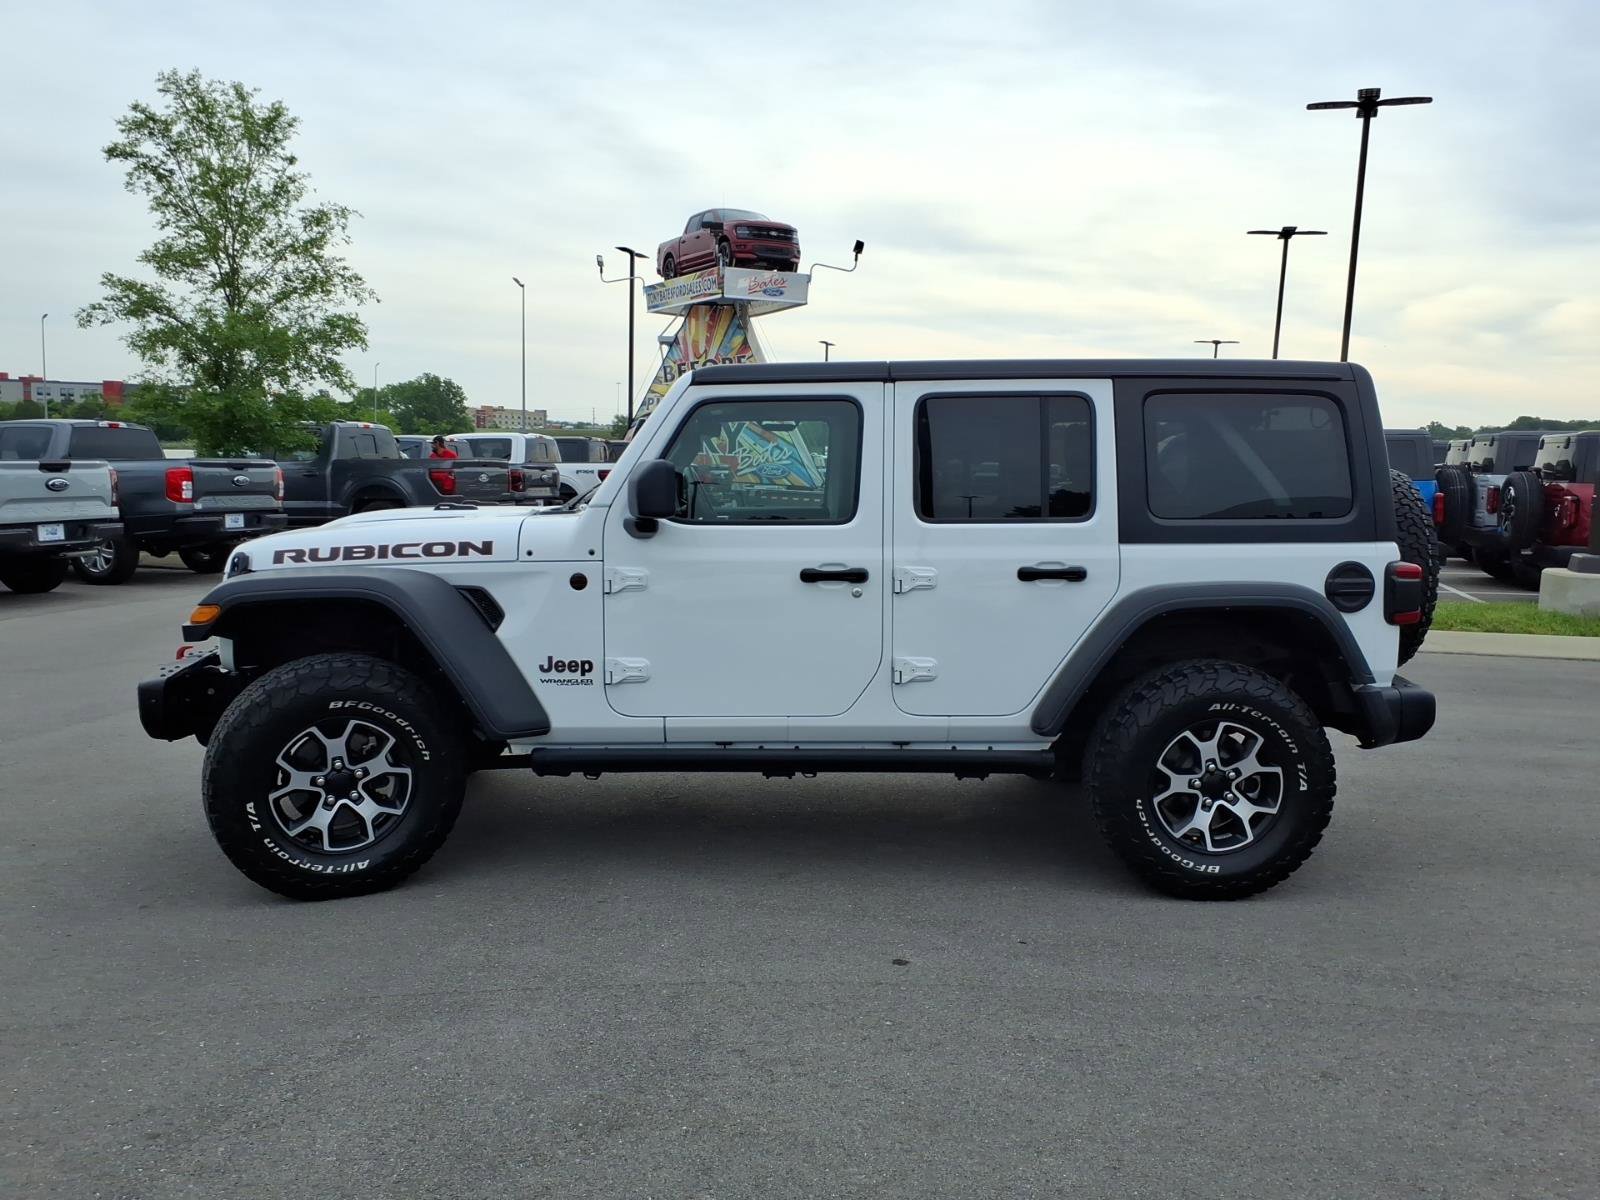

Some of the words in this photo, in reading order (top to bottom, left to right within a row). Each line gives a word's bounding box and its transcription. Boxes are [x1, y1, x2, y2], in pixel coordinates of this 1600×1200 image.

[748, 275, 787, 292] Bates
[733, 442, 792, 472] Bates
[272, 541, 494, 564] RUBICON
[539, 655, 593, 676] Jeep
[328, 700, 431, 761] BFGoodrich
[1208, 703, 1298, 754] All-Terrain
[1297, 762, 1308, 791] T/A
[246, 801, 262, 832] T/A
[1136, 799, 1221, 874] BFGoodrich
[263, 837, 370, 874] All-Terrain
